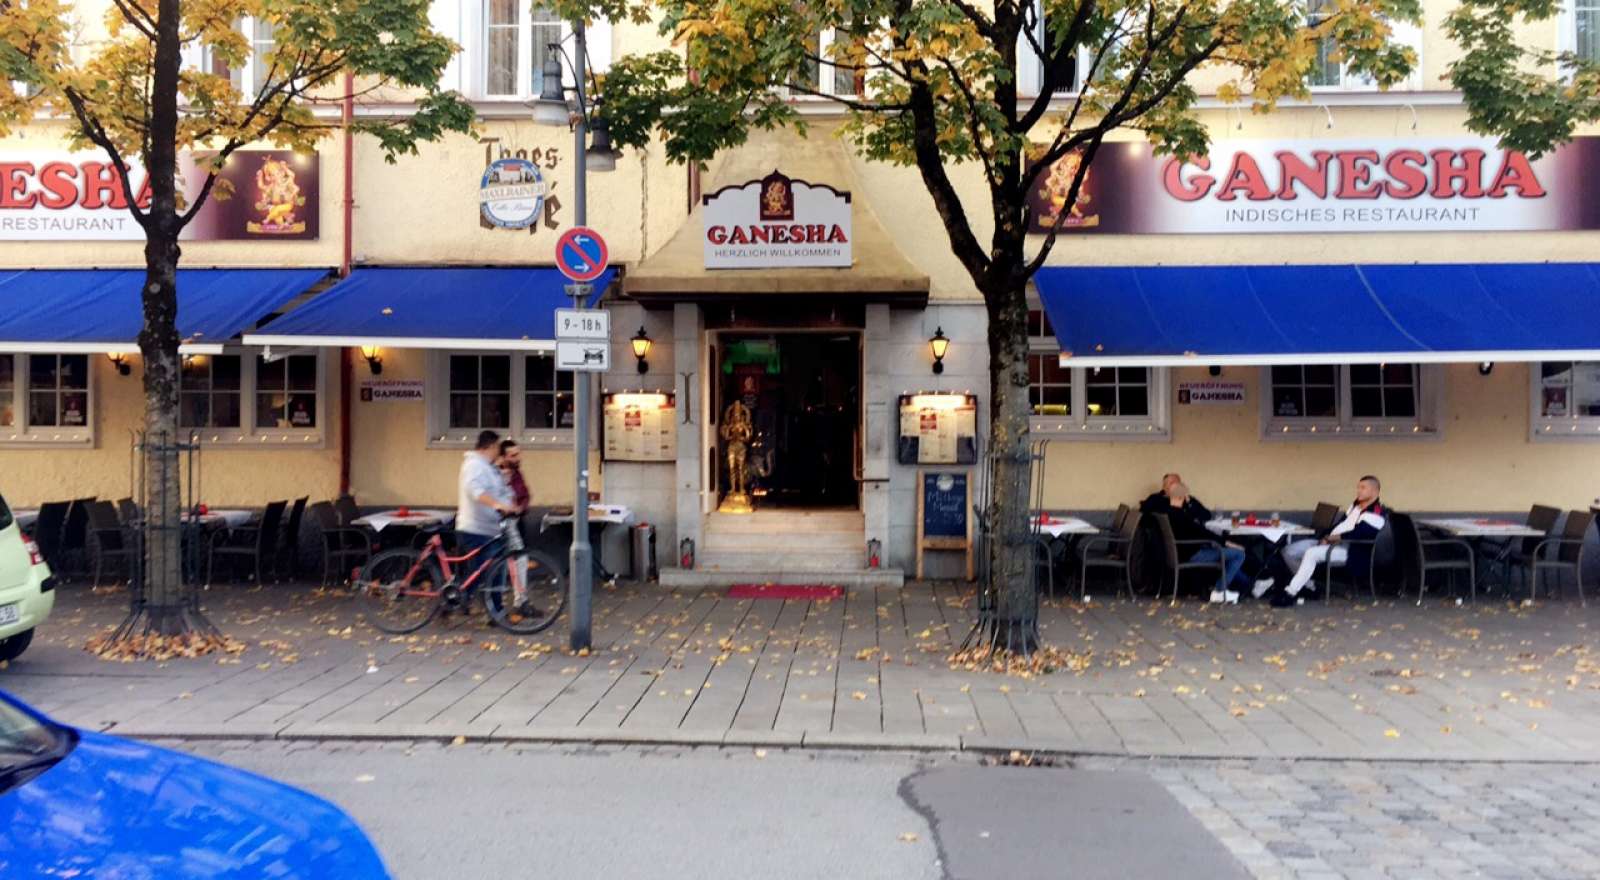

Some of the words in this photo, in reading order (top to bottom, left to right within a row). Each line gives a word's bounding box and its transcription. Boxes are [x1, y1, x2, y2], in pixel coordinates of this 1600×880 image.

[1162, 149, 1547, 202] GANESHA
[0, 161, 153, 210] ESH
[1225, 207, 1336, 223] INDISCHES
[1343, 207, 1480, 222] RESTAURANT
[2, 216, 126, 231] RESTAURANT
[706, 224, 848, 245] GANESHA
[714, 248, 767, 257] HERZLICH
[769, 248, 841, 257] WILLKOMMEN
[564, 318, 571, 331] 9
[581, 318, 593, 331] 18
[594, 319, 601, 331] h
